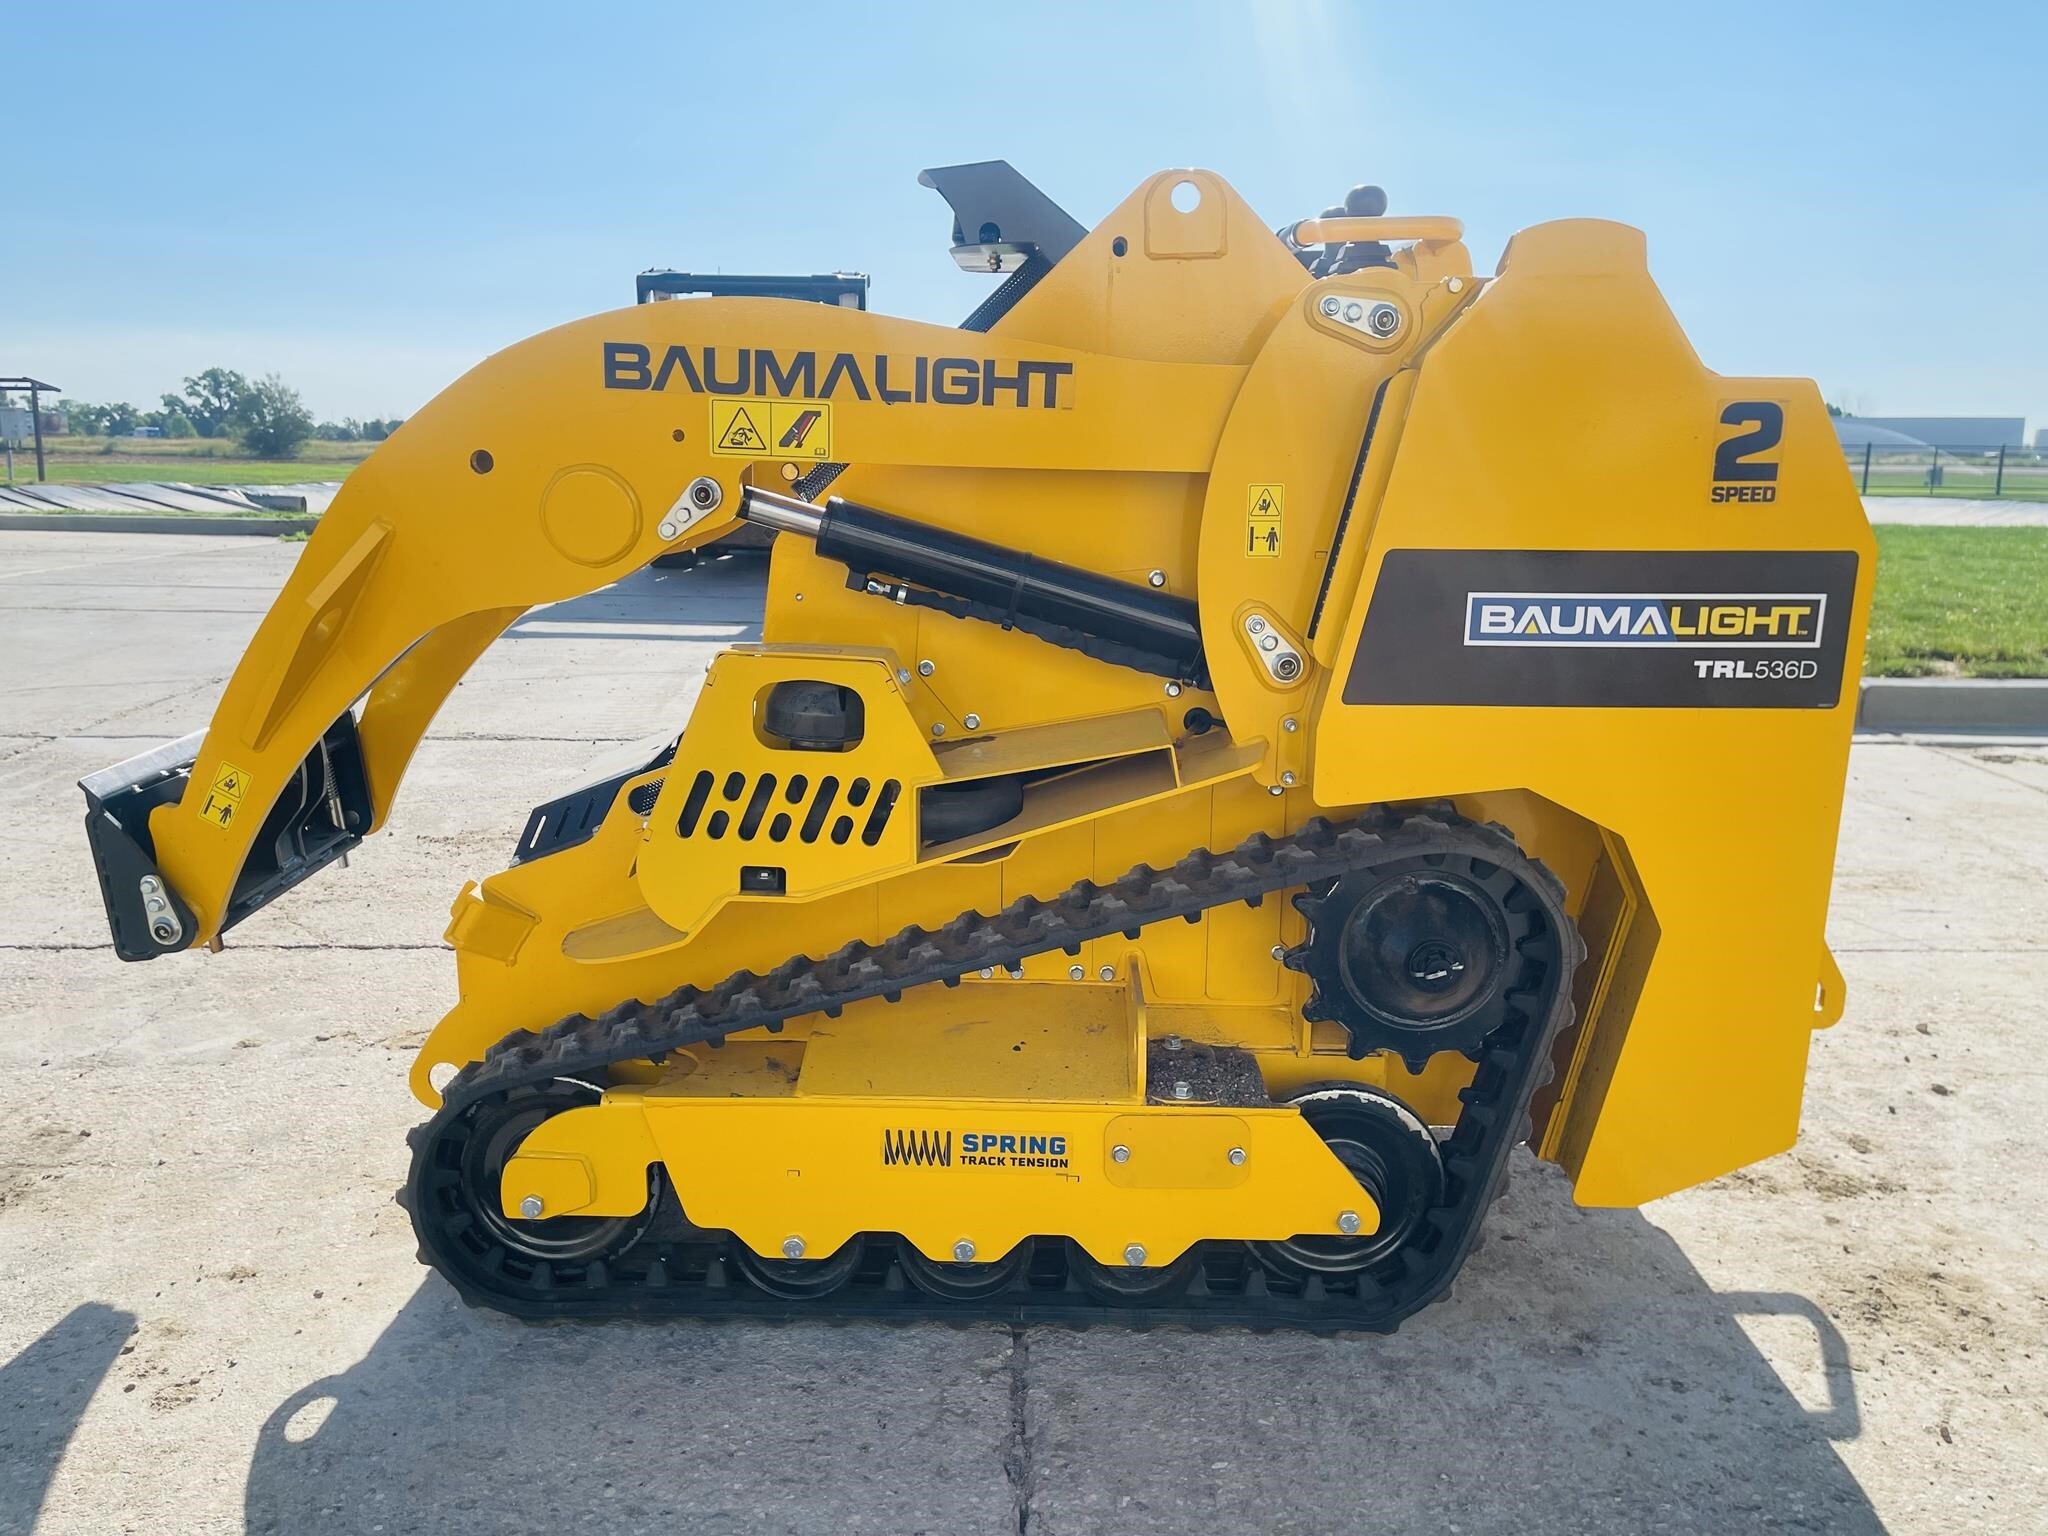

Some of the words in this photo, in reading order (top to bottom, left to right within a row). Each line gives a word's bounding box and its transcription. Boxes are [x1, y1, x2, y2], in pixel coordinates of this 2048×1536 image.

[603, 342, 1073, 408] BAUMALIGHT
[1713, 402, 1783, 481] 2
[1711, 486, 1776, 503] SPEED
[1480, 605, 1811, 635] BAUMALIGHT
[1694, 660, 1818, 680] TRL536D
[962, 1133, 1066, 1155] SPRING
[960, 1155, 1005, 1167] TRACK
[1010, 1157, 1069, 1168] TENSION
